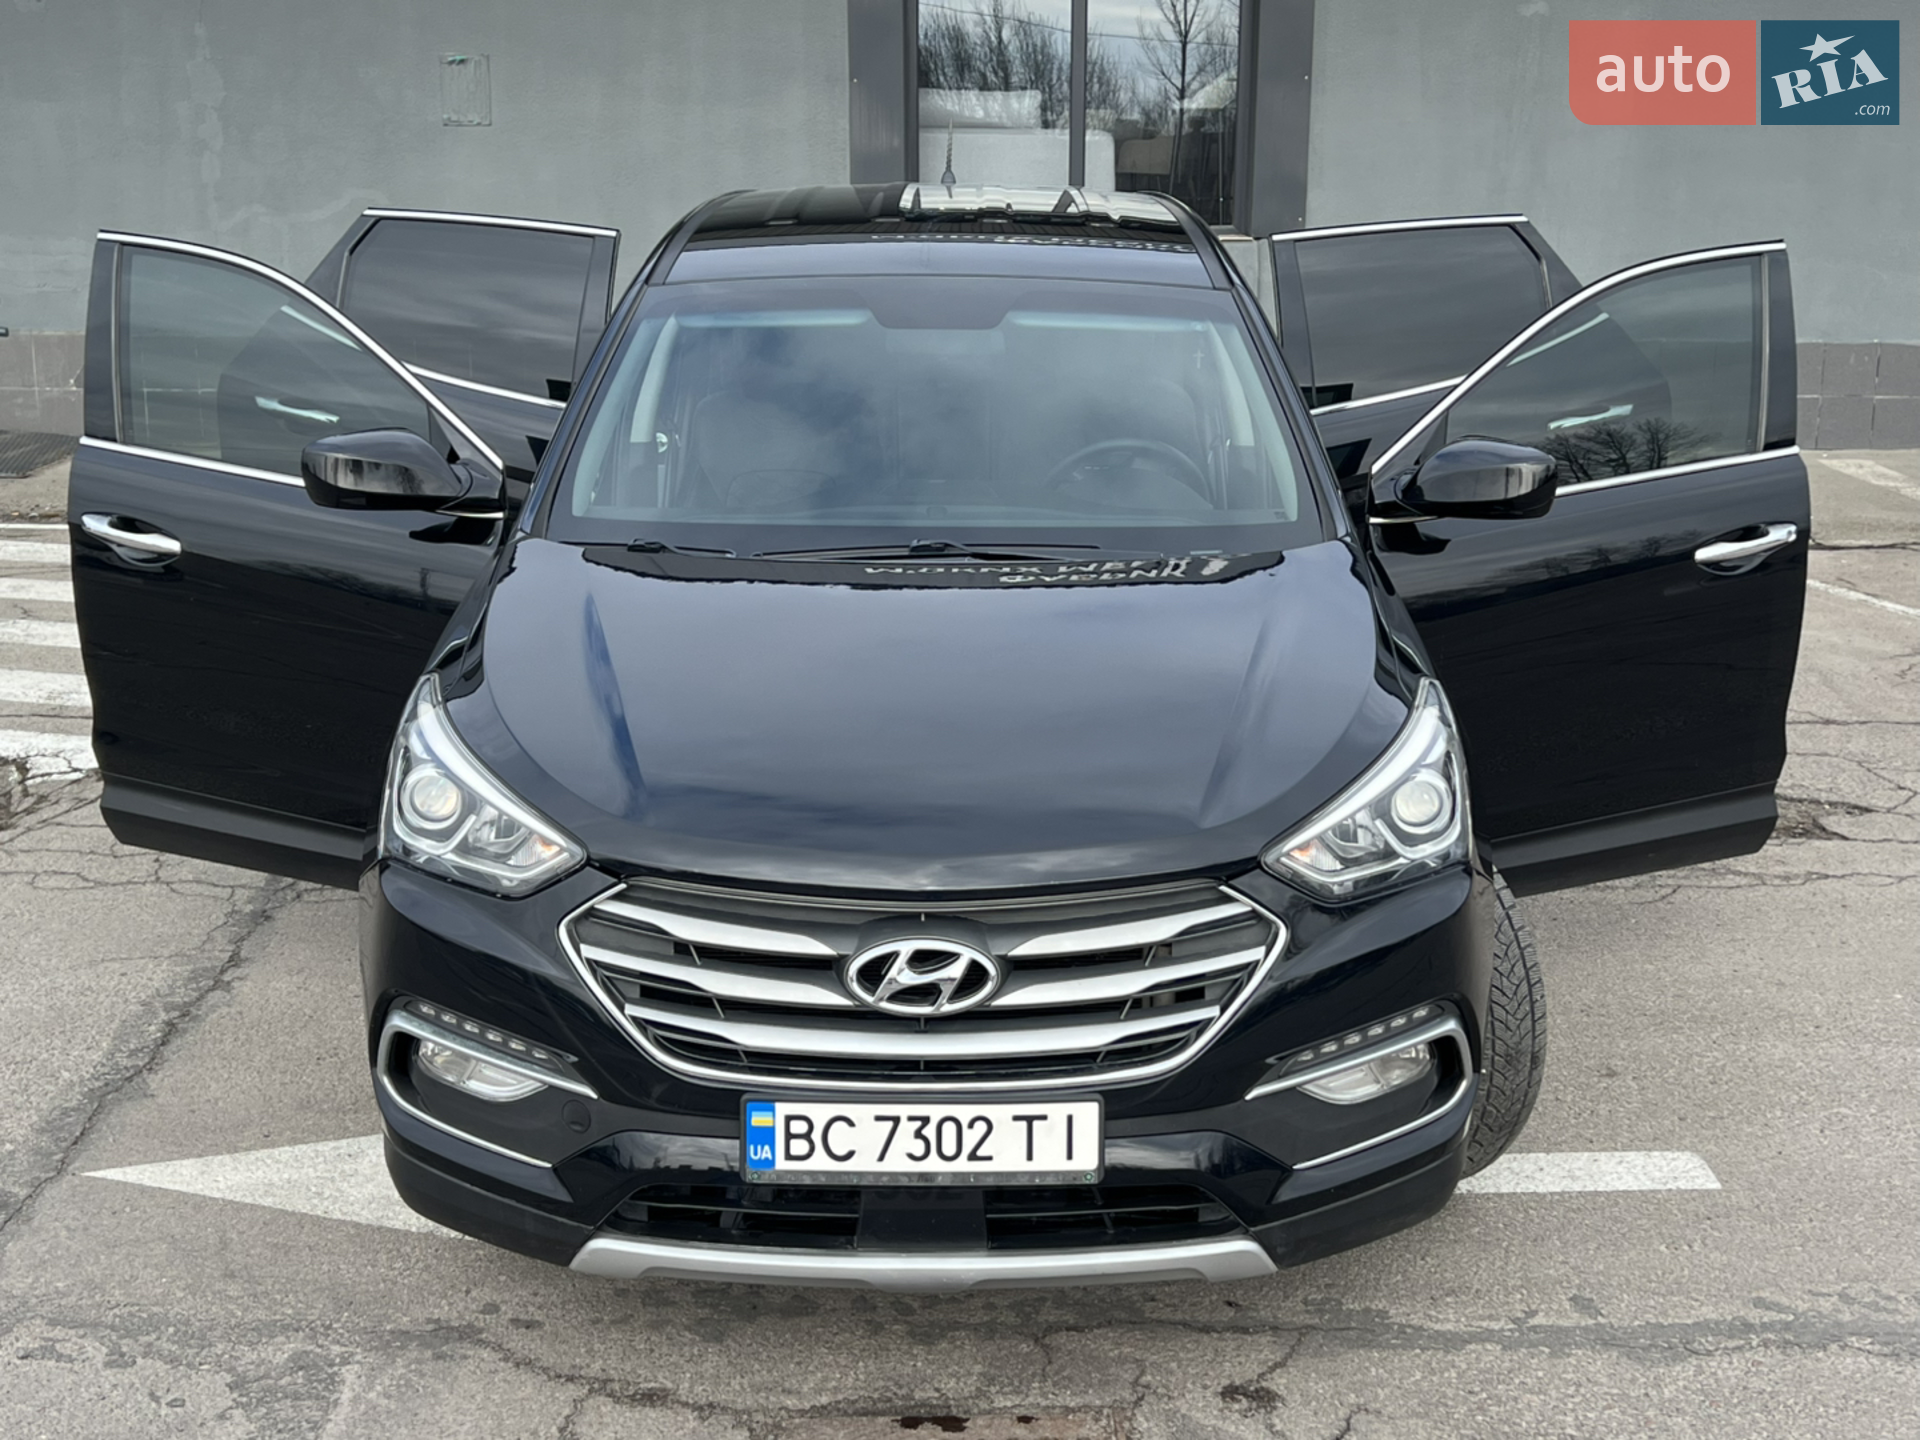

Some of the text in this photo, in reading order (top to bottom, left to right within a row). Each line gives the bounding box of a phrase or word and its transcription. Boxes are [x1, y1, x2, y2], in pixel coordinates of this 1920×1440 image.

[749, 1144, 772, 1161] UA
[783, 1114, 857, 1162] BC
[873, 1115, 994, 1162] 7302
